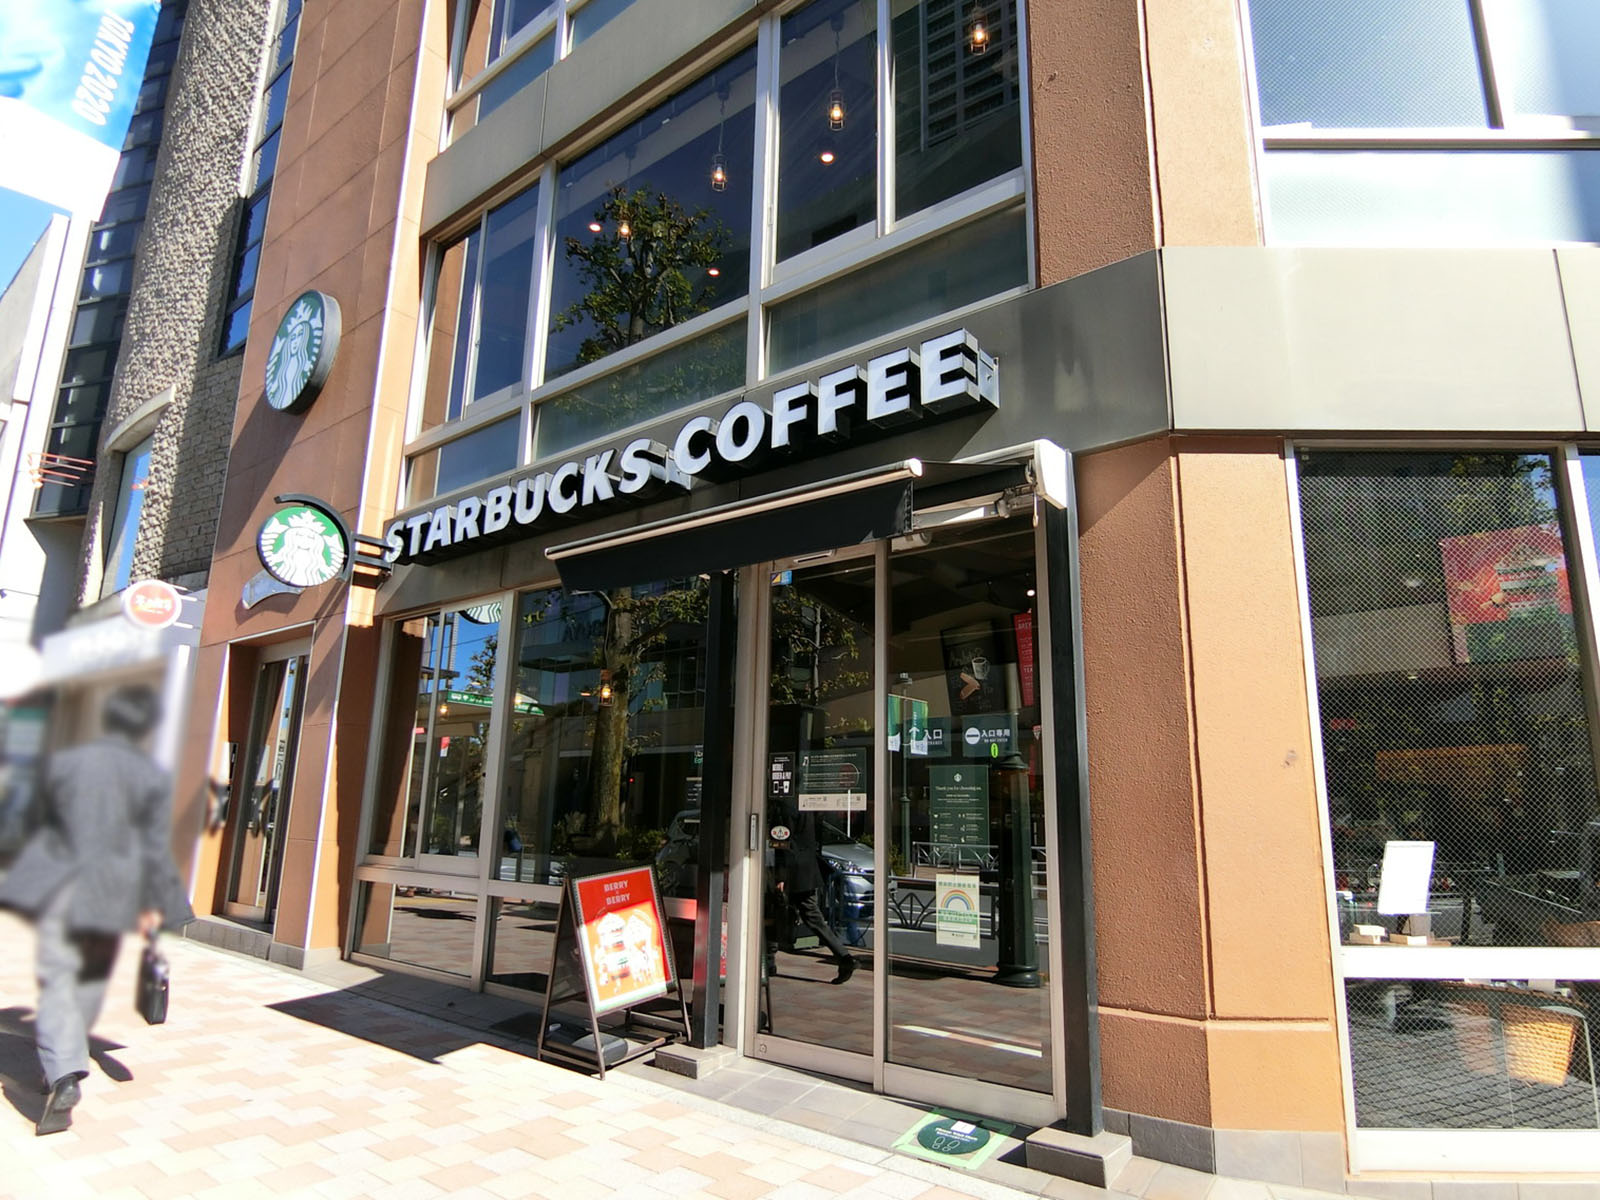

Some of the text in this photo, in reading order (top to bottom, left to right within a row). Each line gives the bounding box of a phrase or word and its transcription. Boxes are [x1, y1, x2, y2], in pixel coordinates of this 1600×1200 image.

[72, 8, 134, 125] TOKYO 2020
[384, 327, 967, 562] STARBUCKS COFFEE
[924, 729, 942, 740] 入口
[604, 880, 628, 892] BERRY
[606, 893, 630, 905] BERRY
